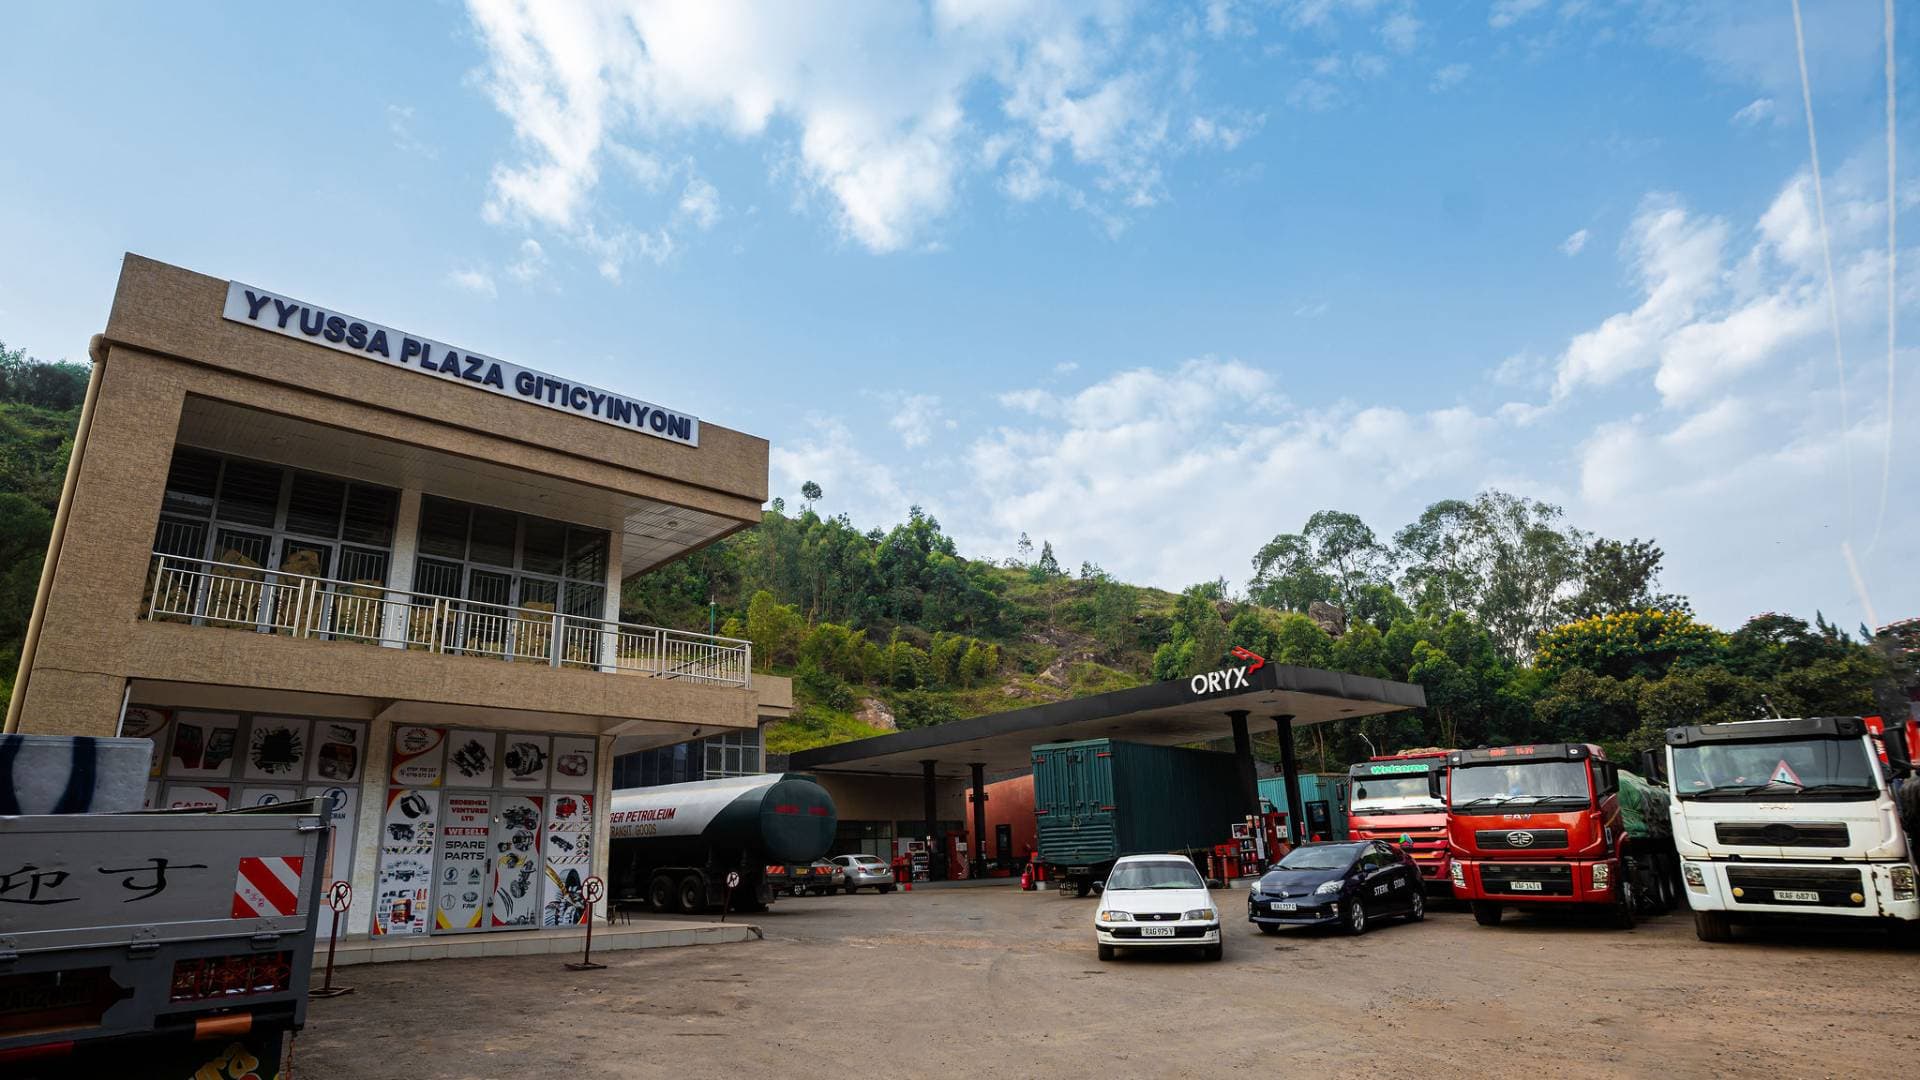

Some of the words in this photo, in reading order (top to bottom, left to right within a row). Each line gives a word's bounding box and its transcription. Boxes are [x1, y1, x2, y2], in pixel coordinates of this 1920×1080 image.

[244, 290, 390, 357] YYUSSA
[400, 338, 504, 389] PLAZA
[515, 371, 691, 440] GITICYINYONI
[1191, 666, 1250, 695] ORYX
[1371, 764, 1429, 775] Welcome
[626, 807, 676, 822] PETROLEUM
[635, 823, 657, 836] GOODS
[445, 841, 486, 849] SPARE
[444, 852, 485, 860] PARTS
